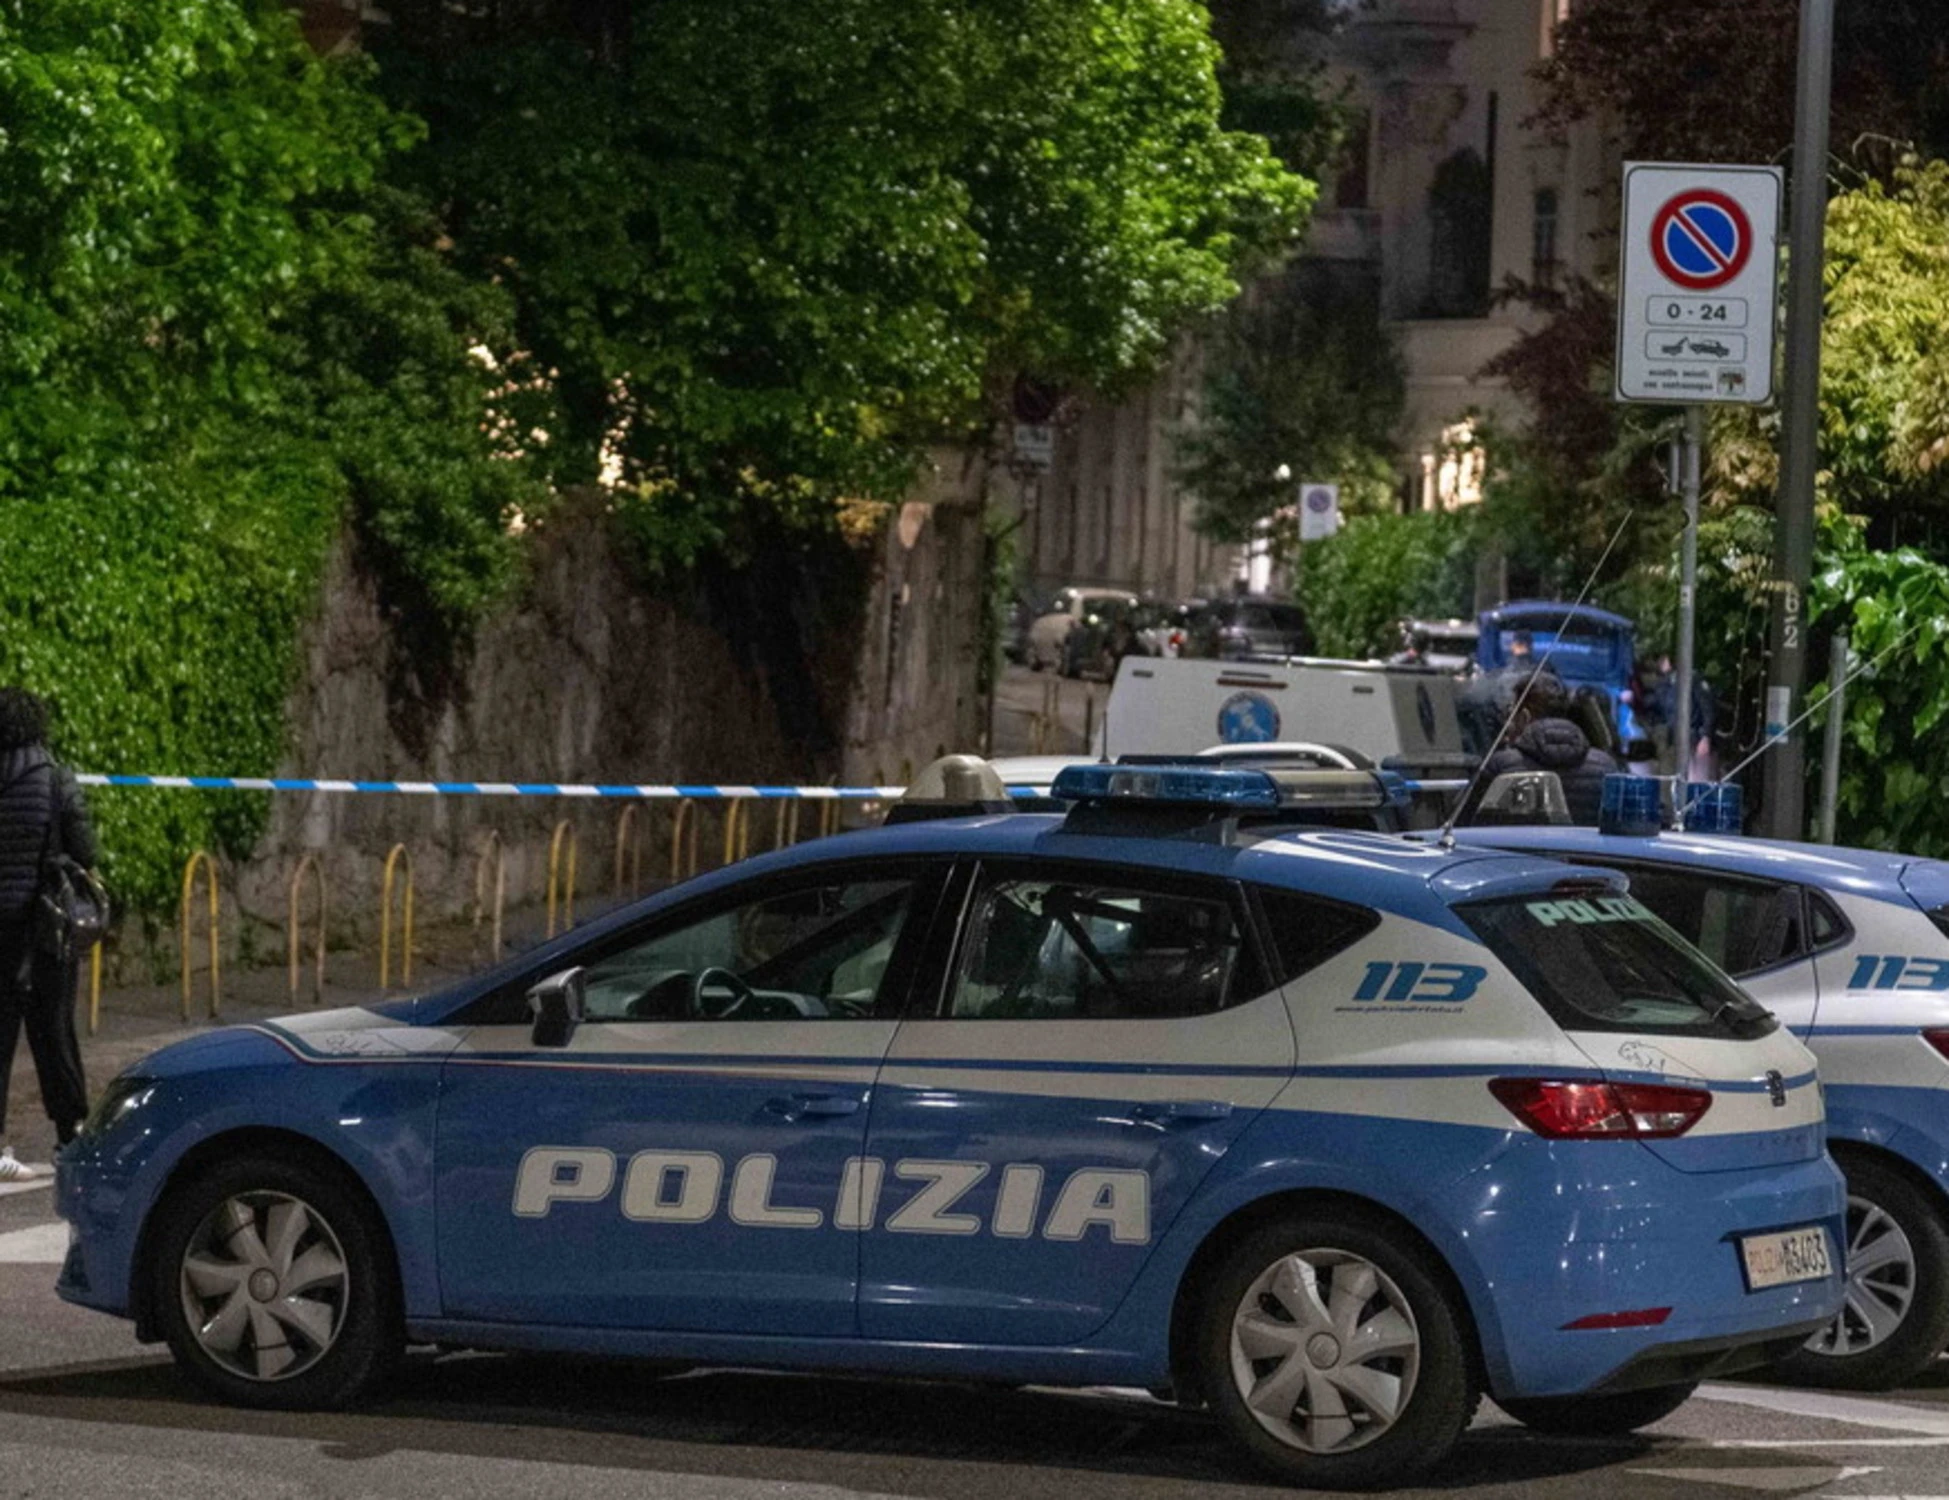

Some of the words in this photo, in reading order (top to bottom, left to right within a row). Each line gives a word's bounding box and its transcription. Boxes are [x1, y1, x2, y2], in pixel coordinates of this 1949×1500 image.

[1667, 303, 1681, 319] 0
[1700, 303, 1727, 321] 24
[1353, 961, 1488, 1002] 113
[1846, 955, 1949, 990] 113
[511, 1145, 1151, 1245] POLIZIA
